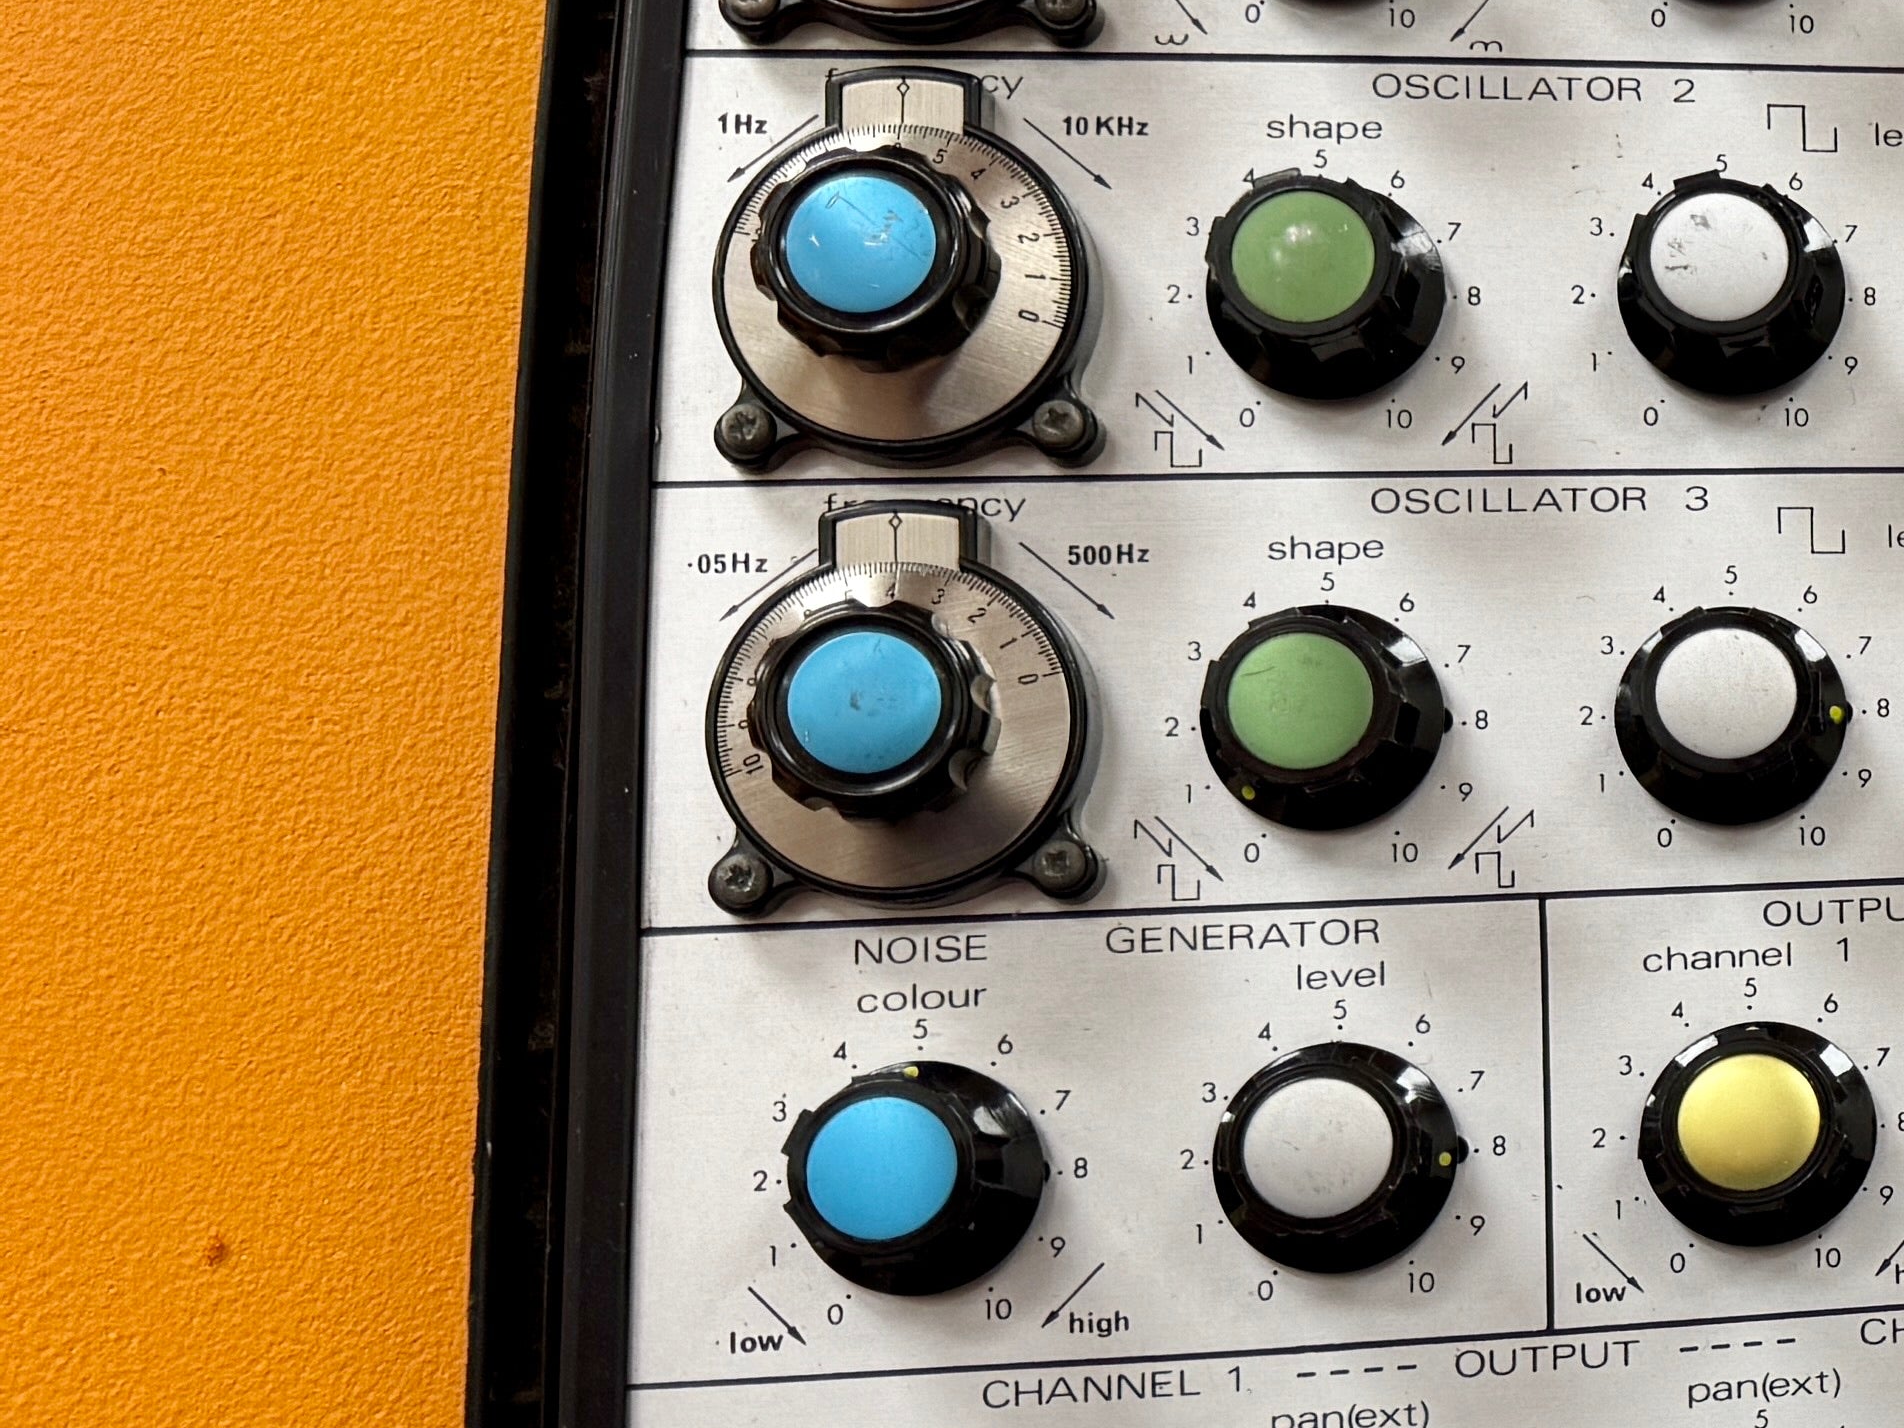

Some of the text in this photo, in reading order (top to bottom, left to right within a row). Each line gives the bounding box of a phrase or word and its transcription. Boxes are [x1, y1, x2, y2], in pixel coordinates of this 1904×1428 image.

[1371, 71, 1697, 104] OSCILLATOR 2
[1369, 484, 1710, 516] OSCILLATOR 3
[1266, 533, 1385, 567] shape
[853, 917, 1381, 967] NOISE GENERATOR
[855, 981, 989, 1015] colour
[1068, 1309, 1131, 1339] high
[728, 1330, 785, 1356] low
[981, 1364, 1242, 1410] CHANNEL 1
